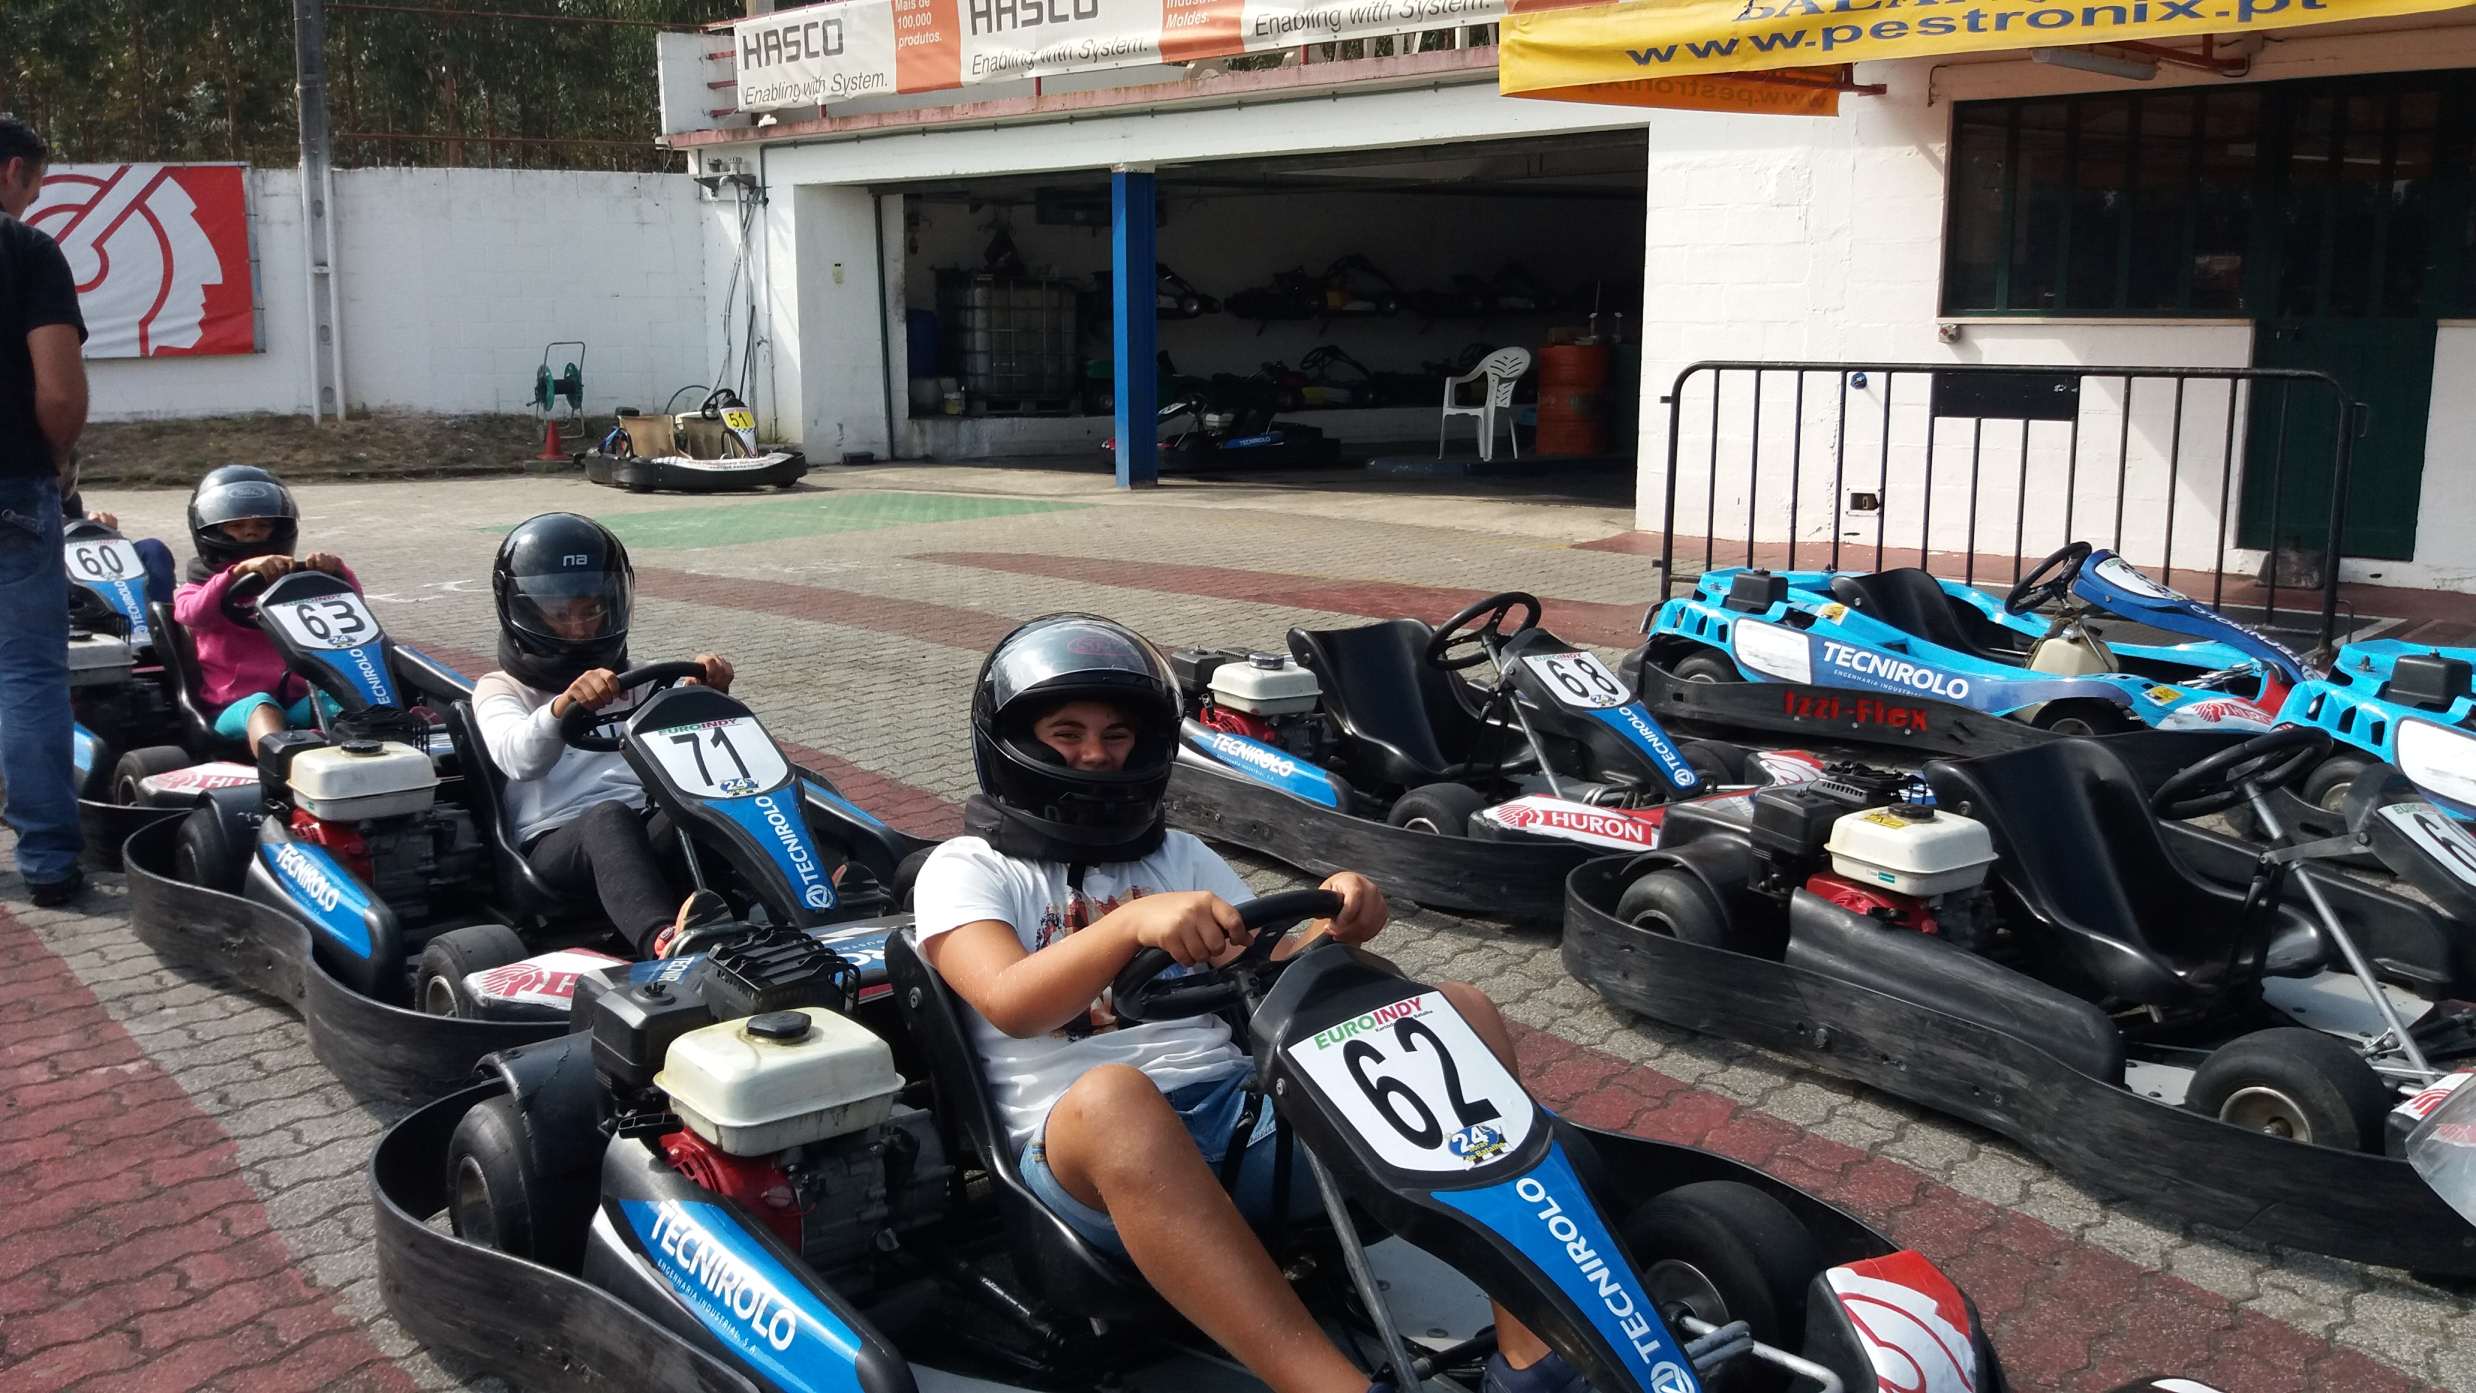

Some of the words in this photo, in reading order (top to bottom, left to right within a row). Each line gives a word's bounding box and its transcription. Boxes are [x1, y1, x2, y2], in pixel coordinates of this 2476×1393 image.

[897, 12, 932, 30] 100,000
[1166, 11, 1209, 29] Moldes.
[1255, 9, 1342, 36] Enabling
[1349, 1, 1391, 25] with
[742, 18, 844, 70] HASCO
[898, 32, 942, 50] produtos.
[971, 50, 1035, 75] Enabling
[1040, 42, 1073, 64] with
[1078, 36, 1148, 64] System.
[745, 80, 800, 105] Enabling
[803, 75, 826, 97] with
[830, 72, 888, 97] System.
[729, 413, 748, 427] 51
[76, 545, 124, 577] 60
[296, 600, 366, 640] 63
[350, 648, 391, 705] ECNIROLO
[1546, 658, 1619, 698] 68
[1823, 641, 1969, 699] TECNIROLO
[658, 718, 737, 736] EUROINDY
[1618, 706, 1681, 771] TECNIROLO
[669, 727, 751, 786] 71
[1212, 733, 1294, 777] TECNIROLO
[724, 780, 748, 790] 24
[755, 796, 819, 886] TECNIROLO
[1551, 812, 1643, 842] HURON
[276, 843, 340, 912] TECNIROLO
[1313, 997, 1422, 1050] EUROINDY
[1342, 1016, 1502, 1150] 62
[1452, 1126, 1489, 1153] 24
[651, 1198, 797, 1351] TECNIROLO
[1515, 1176, 1662, 1365] TECNIROLO
